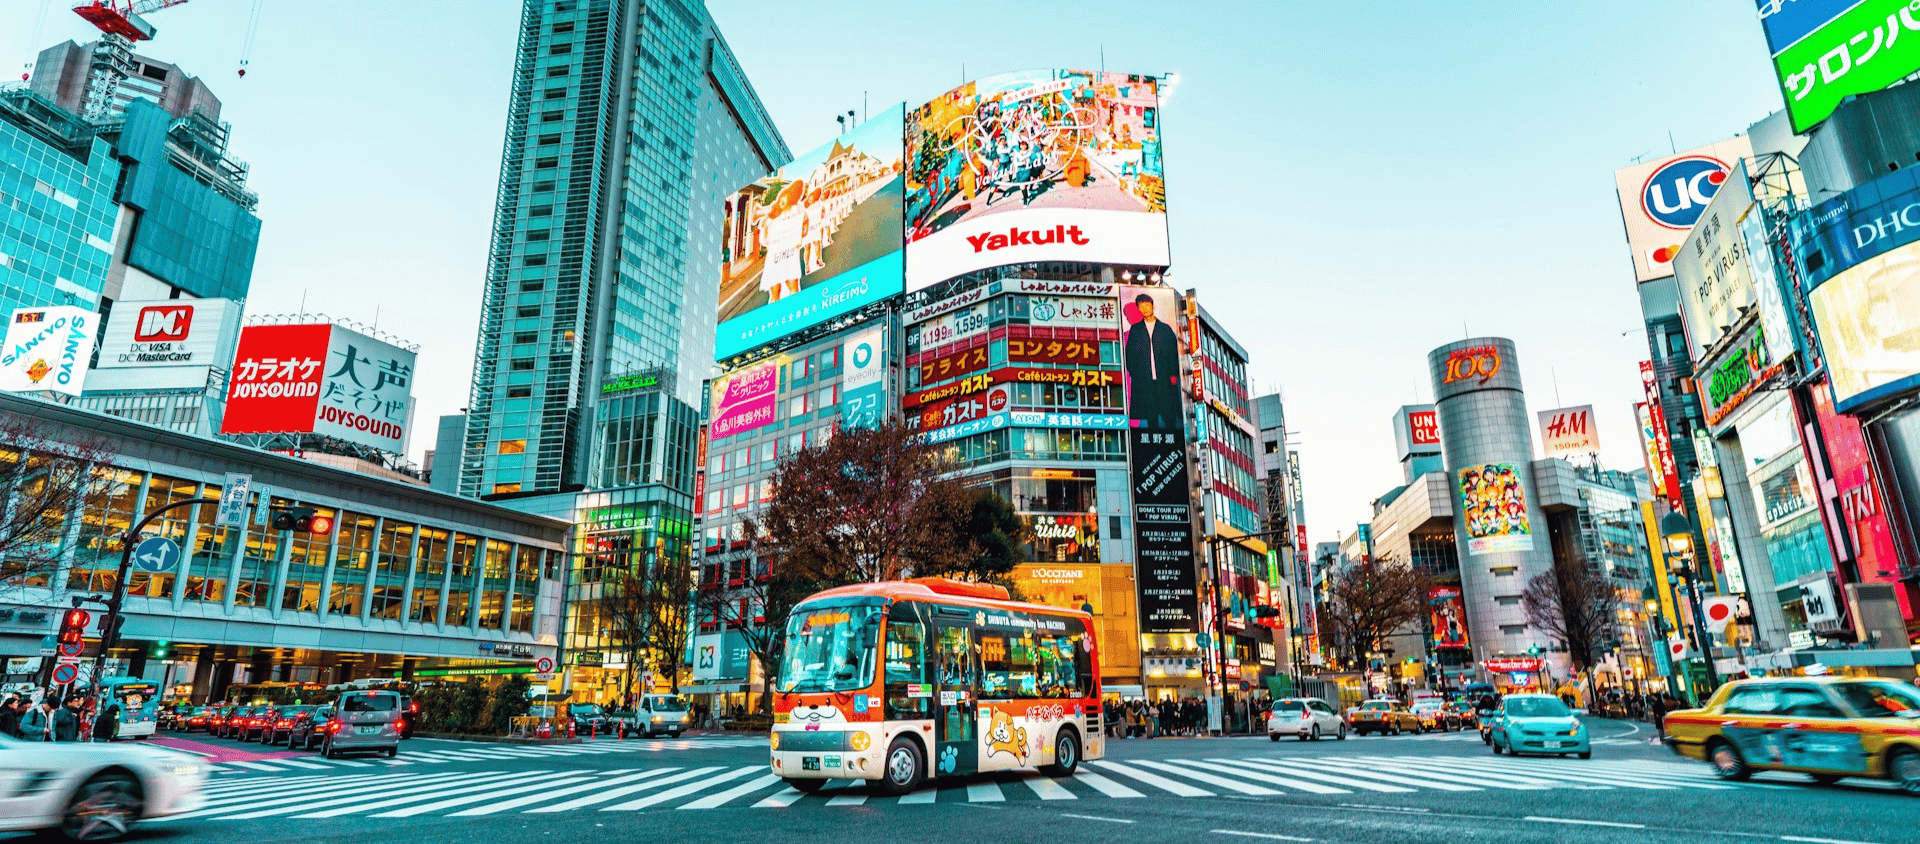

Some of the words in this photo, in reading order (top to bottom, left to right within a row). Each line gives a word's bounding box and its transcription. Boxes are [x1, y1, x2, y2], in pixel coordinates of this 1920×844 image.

[1810, 200, 1849, 228] Channel
[1852, 203, 1920, 249] DHC
[966, 224, 1090, 253] Yakult
[821, 281, 869, 310] KIREIMO
[1020, 280, 1113, 295] しゃぶしゃぶバイキング
[911, 288, 983, 321] しゃぶしゃぶバイキング
[1060, 301, 1115, 320] しゃぶ葉
[139, 309, 187, 337] DC
[1, 316, 67, 367] SANKYO
[57, 315, 88, 385] SANKYO
[130, 343, 147, 352] DC
[149, 342, 172, 352] VISA
[177, 343, 186, 351] &
[907, 333, 920, 346] 9F
[1008, 340, 1097, 359] コンタクト
[118, 353, 134, 363] DC
[136, 351, 193, 362] MasterCard
[328, 344, 411, 391] 大声
[922, 347, 987, 380] プライス
[1443, 353, 1501, 385] 109
[236, 357, 321, 382] カラオケ
[847, 368, 877, 384] eyecity
[1072, 369, 1114, 387] ガスト
[232, 381, 319, 399] JOYSOUND
[960, 373, 994, 396] ガスト
[318, 404, 402, 440] JOYSOUND
[907, 416, 921, 430] 7F
[942, 398, 984, 426] ガスト
[1048, 414, 1126, 427] 英会話イーオン
[929, 419, 990, 443] 英会話イーオン
[1547, 410, 1587, 439] H&M
[1152, 482, 1165, 496] NOW
[1163, 474, 1172, 484] ON
[228, 478, 247, 522] 渋谷駅前
[581, 521, 618, 531] MARK
[623, 517, 654, 527] CITY
[987, 614, 1010, 626] SHIBUYA
[1010, 618, 1036, 630] community
[1037, 618, 1046, 629] bus
[1259, 641, 1276, 660] LUSH
